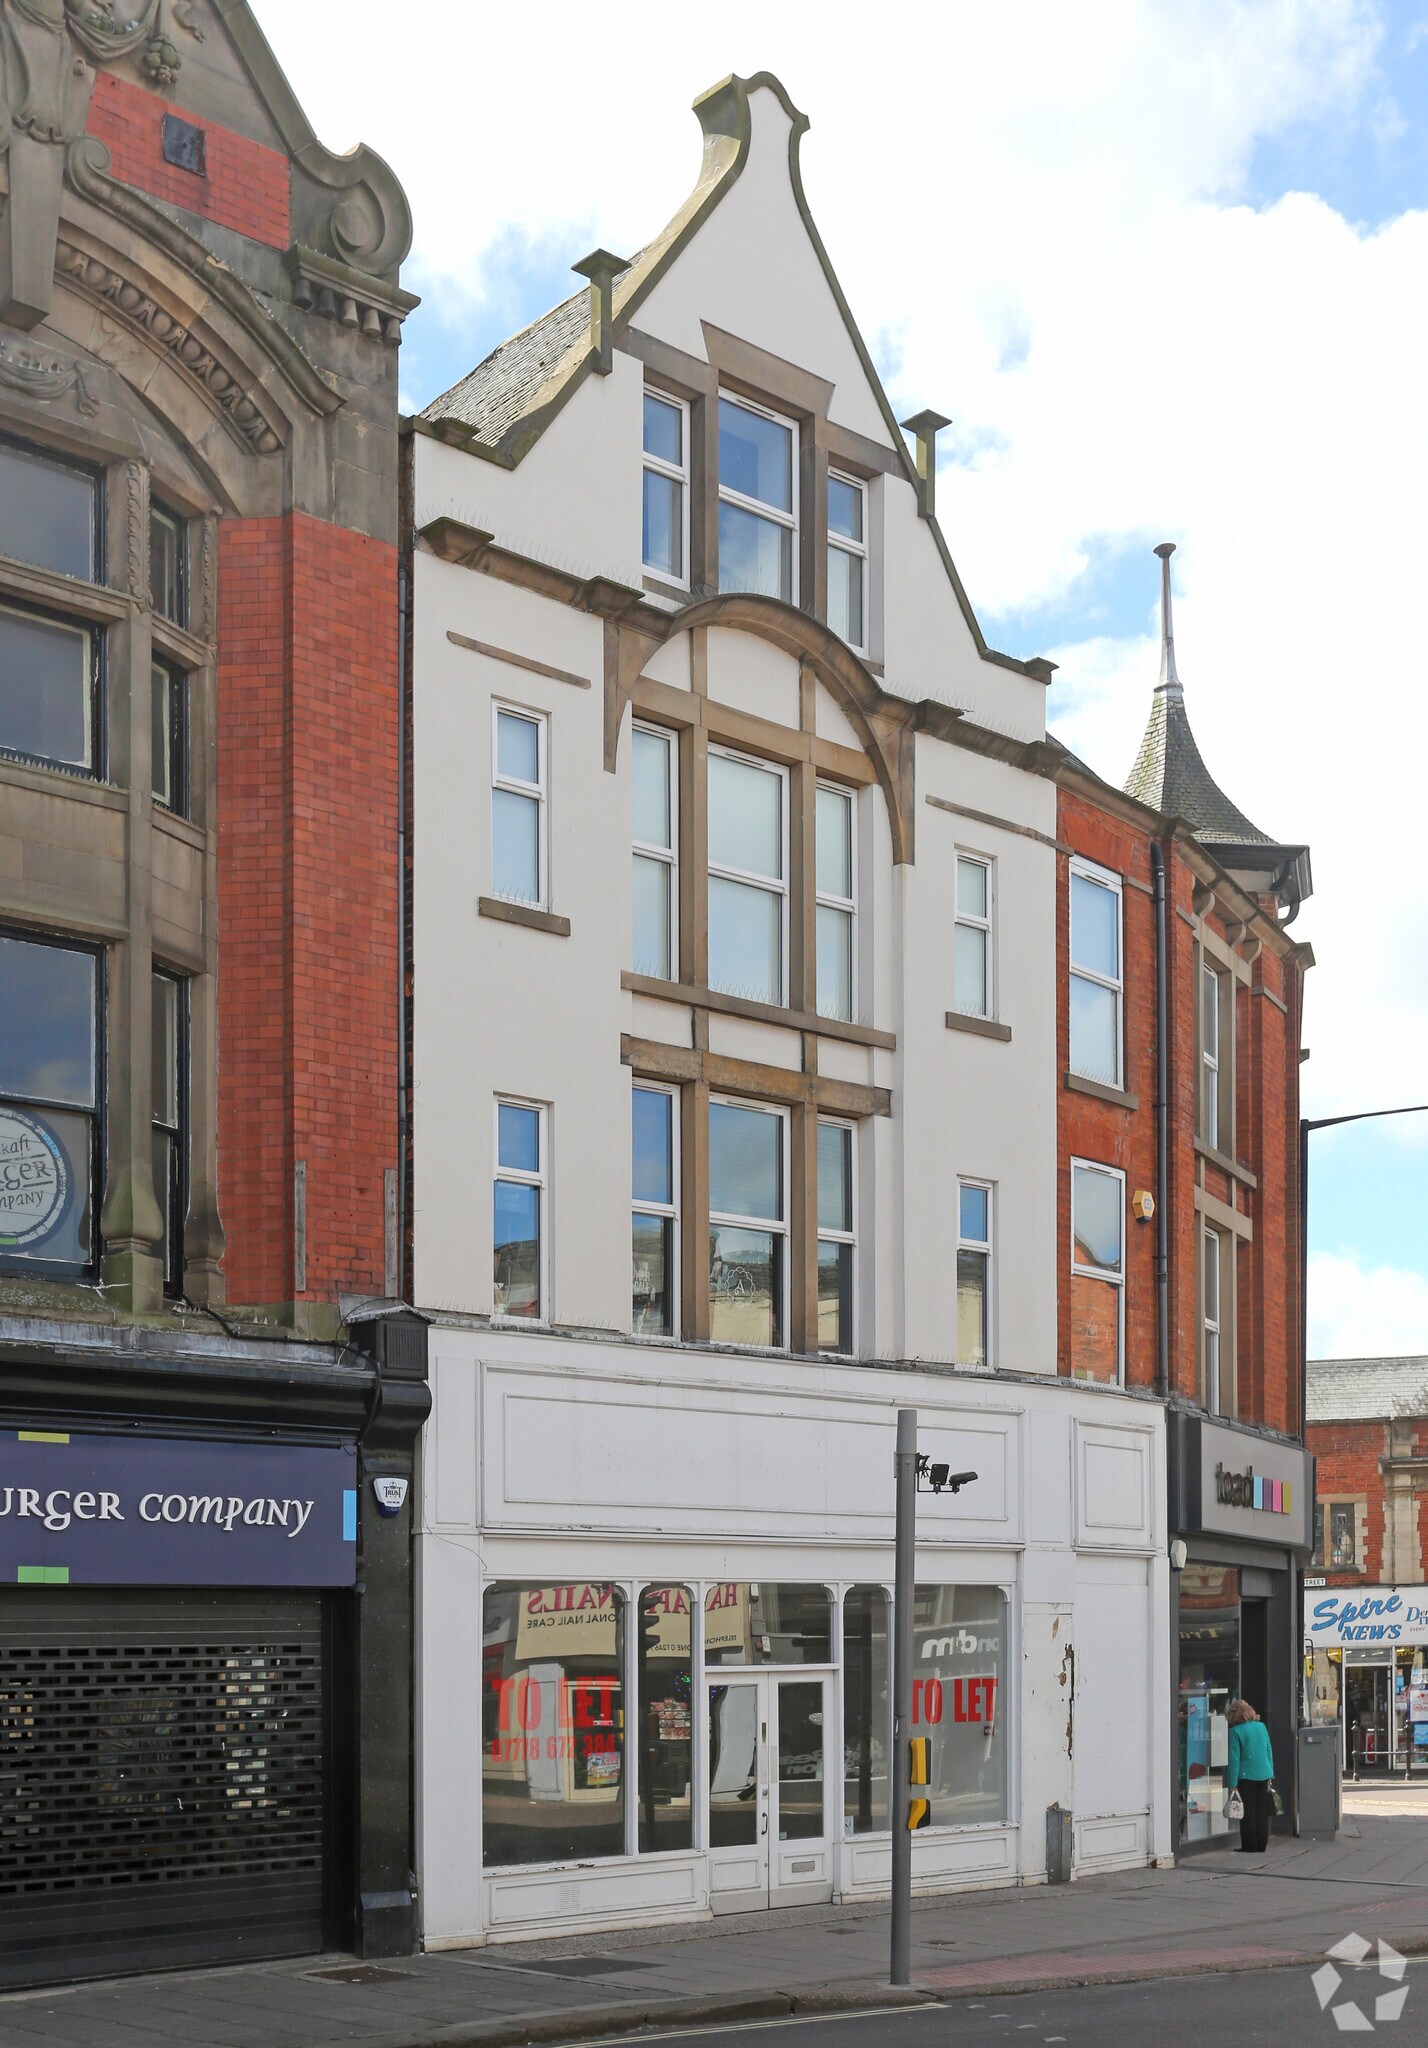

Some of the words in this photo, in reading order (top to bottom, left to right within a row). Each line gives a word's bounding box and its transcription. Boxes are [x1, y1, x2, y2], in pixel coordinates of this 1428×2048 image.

[1311, 1594, 1403, 1633] Spire
[1340, 1624, 1402, 1641] NEWS
[491, 1677, 542, 1731] TO
[557, 1675, 617, 1729] LET
[911, 1678, 942, 1725] TO
[954, 1678, 998, 1723] LET
